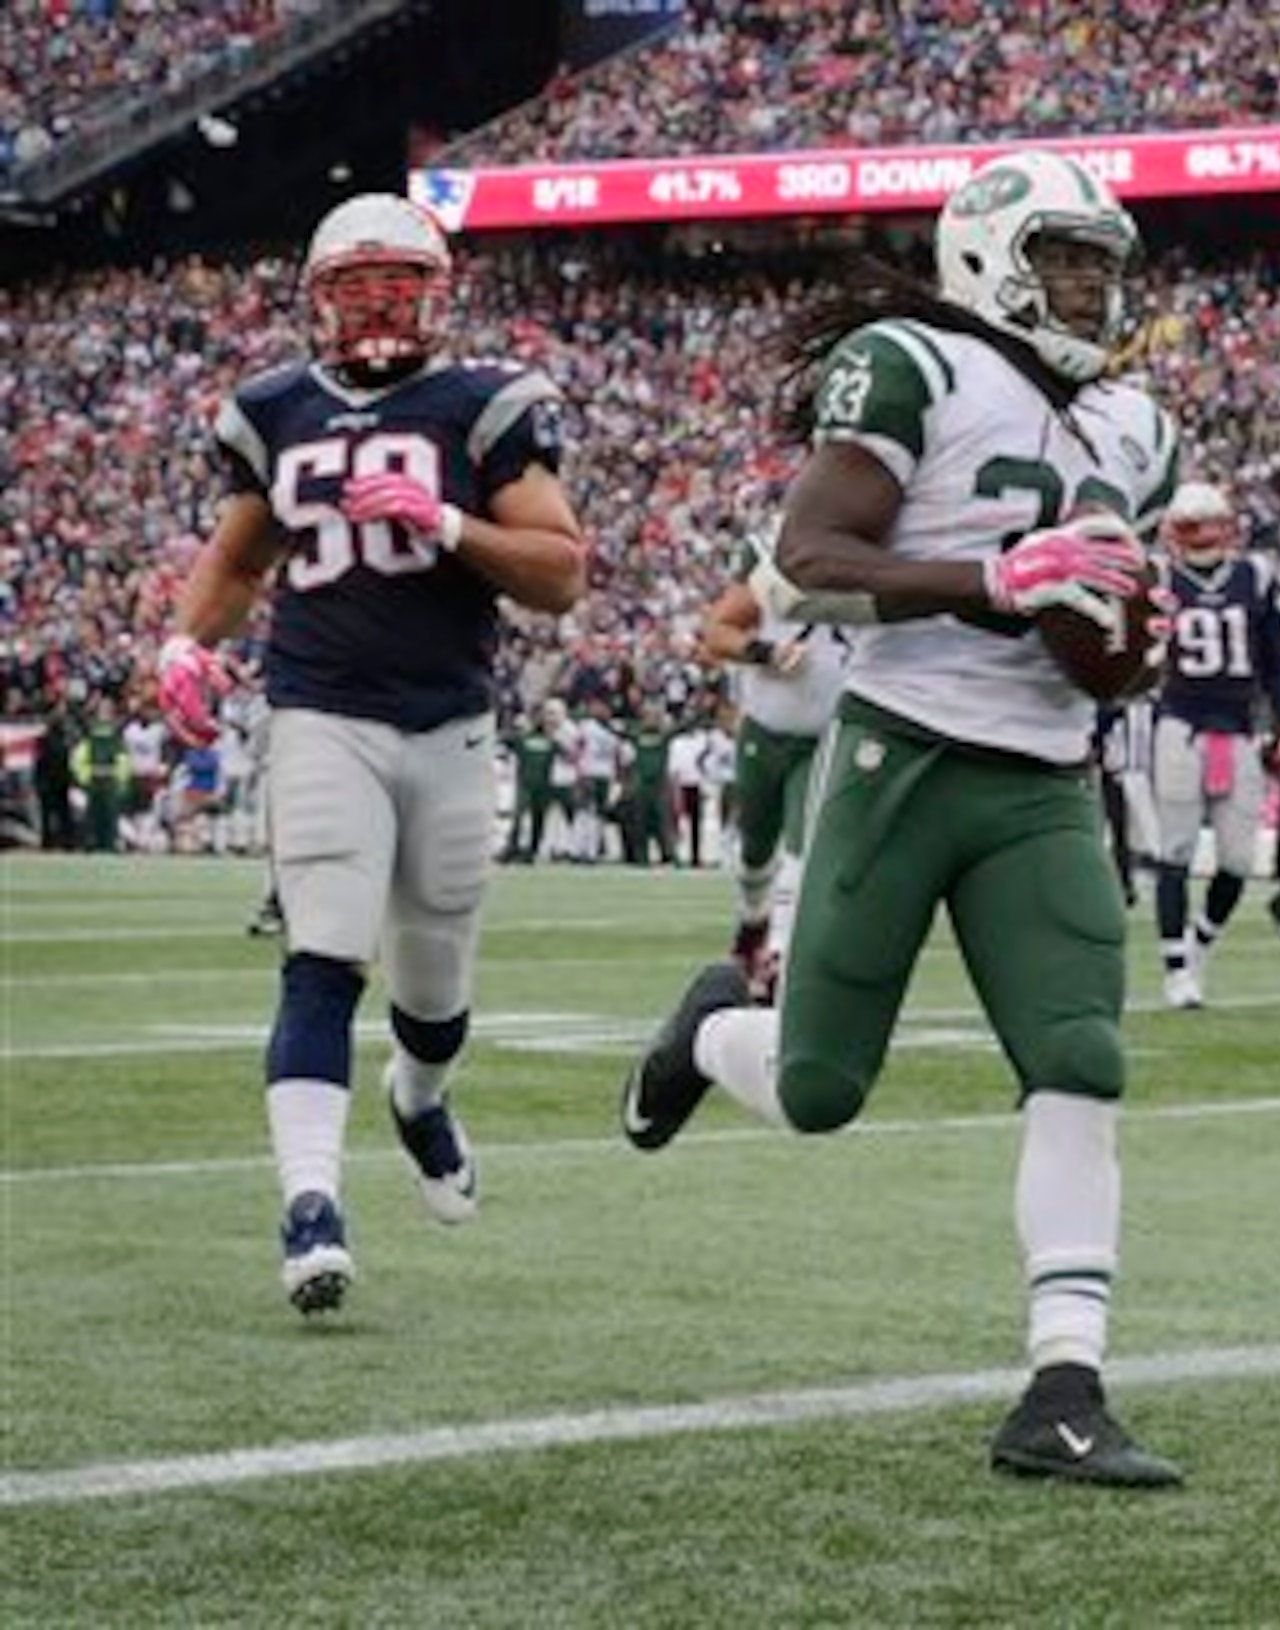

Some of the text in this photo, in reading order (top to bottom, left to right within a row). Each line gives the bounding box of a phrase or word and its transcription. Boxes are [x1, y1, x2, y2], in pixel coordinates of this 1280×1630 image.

[777, 163, 849, 199] 3RD
[857, 156, 972, 197] DOWN
[820, 366, 872, 425] 33
[1177, 607, 1253, 678] 91
